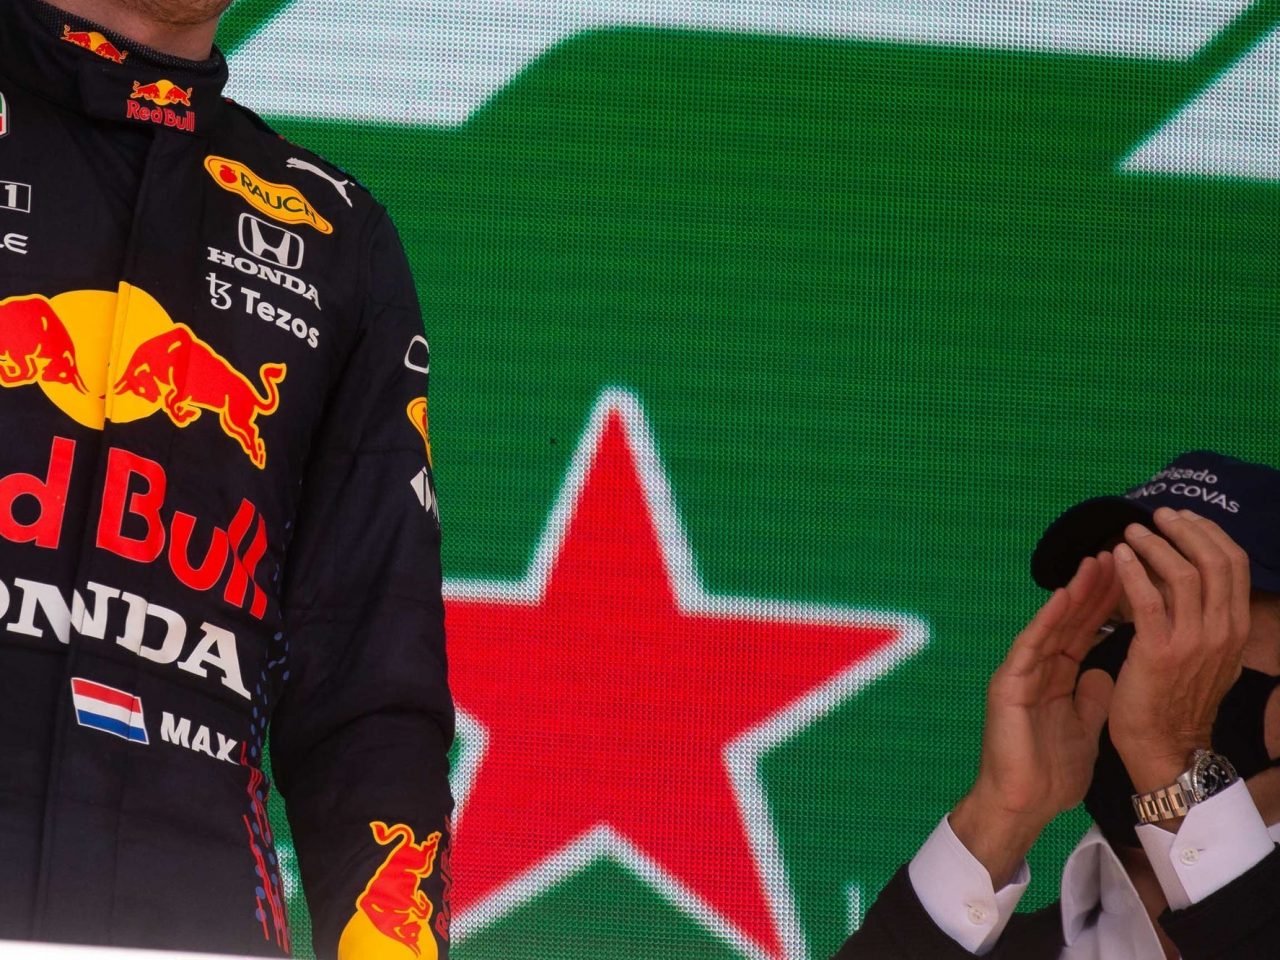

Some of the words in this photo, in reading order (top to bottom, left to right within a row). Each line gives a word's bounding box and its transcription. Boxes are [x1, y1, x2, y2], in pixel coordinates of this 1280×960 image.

[126, 99, 163, 124] Red
[164, 107, 196, 132] Bull
[240, 171, 317, 224] RAUCH
[207, 246, 322, 311] HONDA
[240, 286, 320, 349] Tezos
[1170, 482, 1241, 514] COVAS
[96, 446, 268, 620] Bull
[160, 711, 240, 765] MAX
